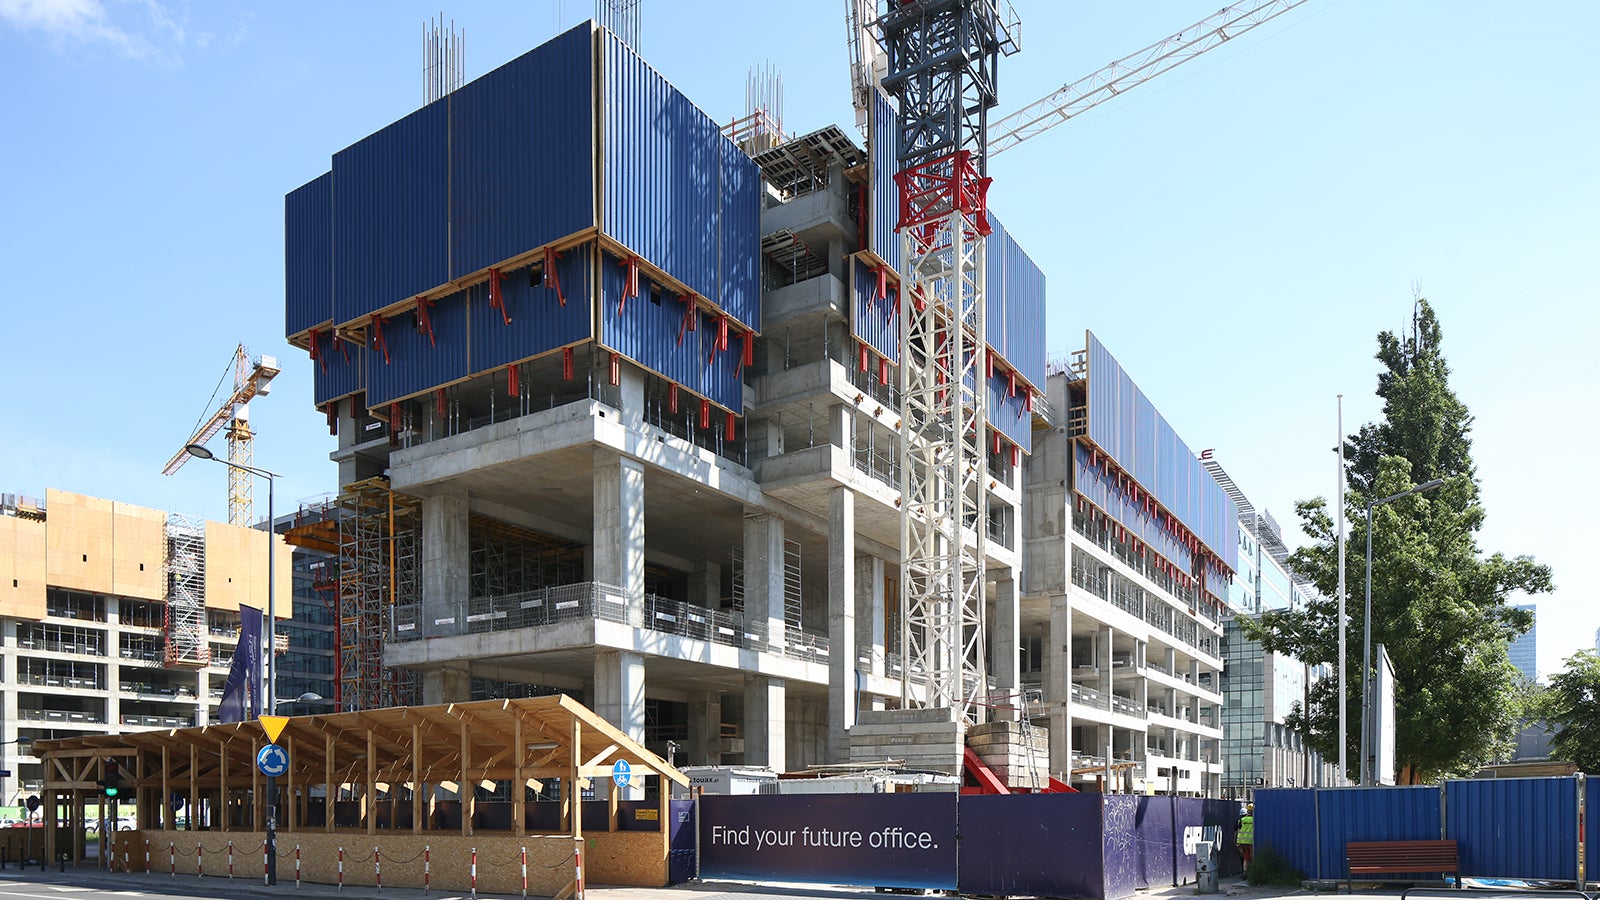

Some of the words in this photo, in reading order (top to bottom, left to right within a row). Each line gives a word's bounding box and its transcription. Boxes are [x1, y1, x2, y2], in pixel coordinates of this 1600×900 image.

[712, 825, 750, 846] Find
[754, 828, 797, 851] your
[801, 826, 863, 848] future
[868, 827, 938, 849] office.
